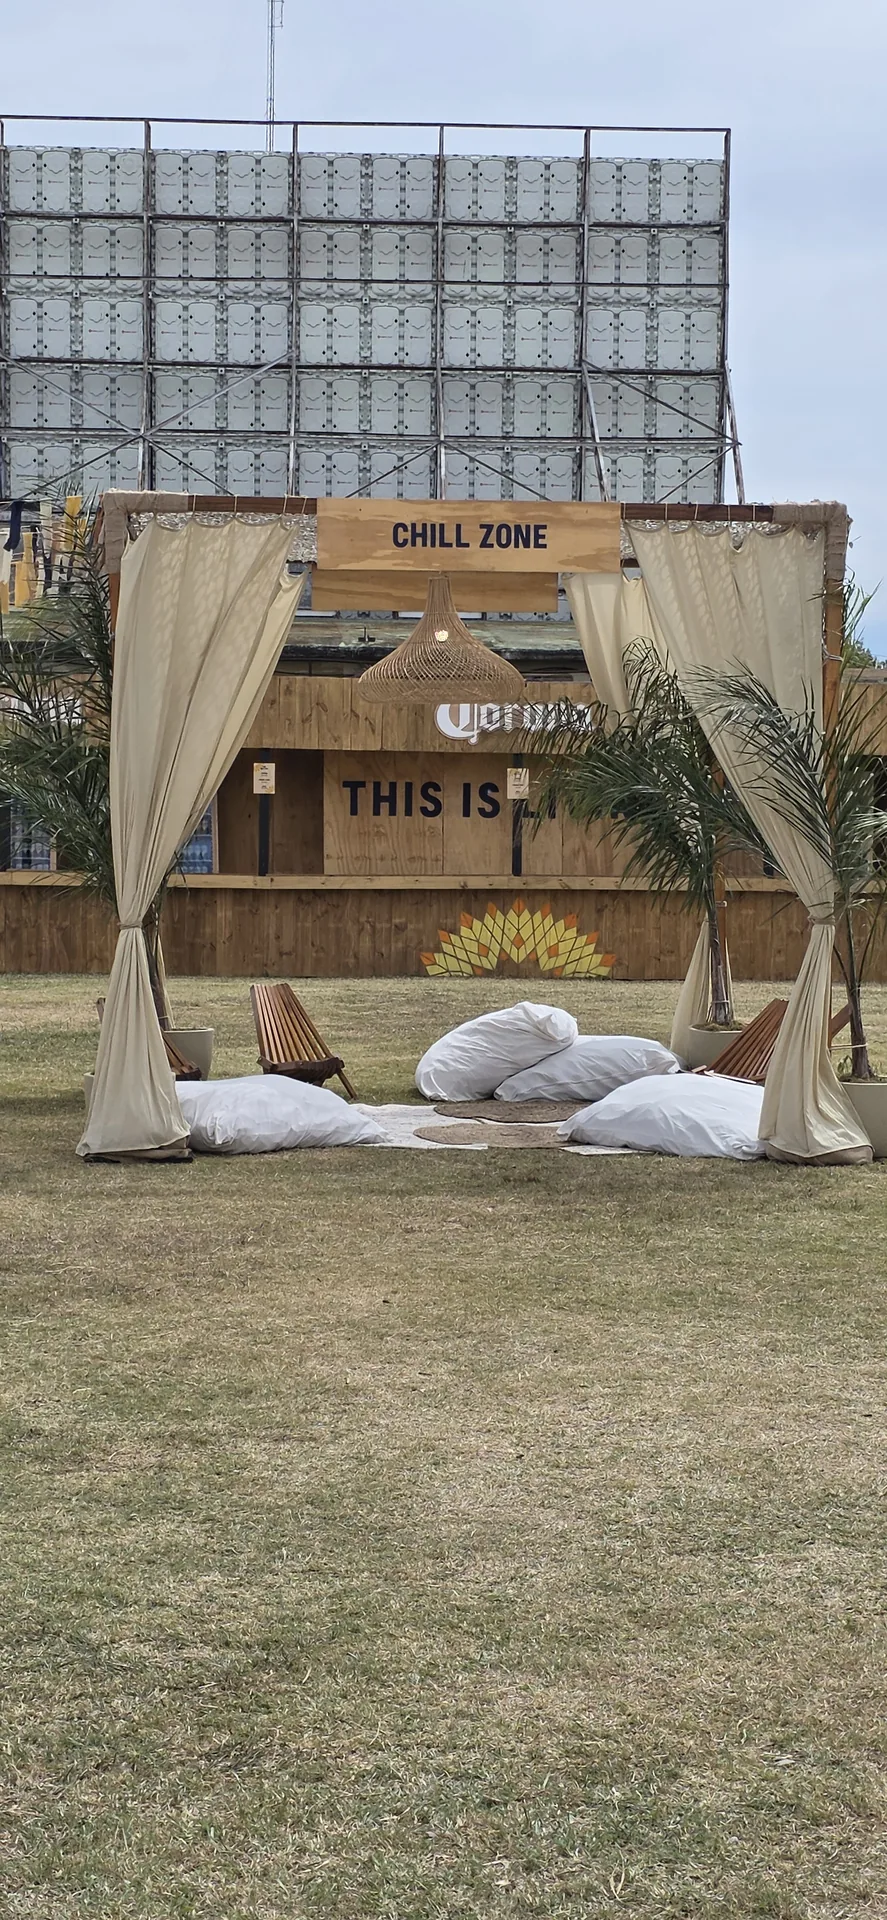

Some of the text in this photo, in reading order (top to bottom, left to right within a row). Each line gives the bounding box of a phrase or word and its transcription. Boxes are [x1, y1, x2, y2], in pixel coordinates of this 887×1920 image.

[392, 522, 548, 549] CHILL ZONE
[342, 780, 443, 818] THIS
[462, 781, 501, 819] IS
